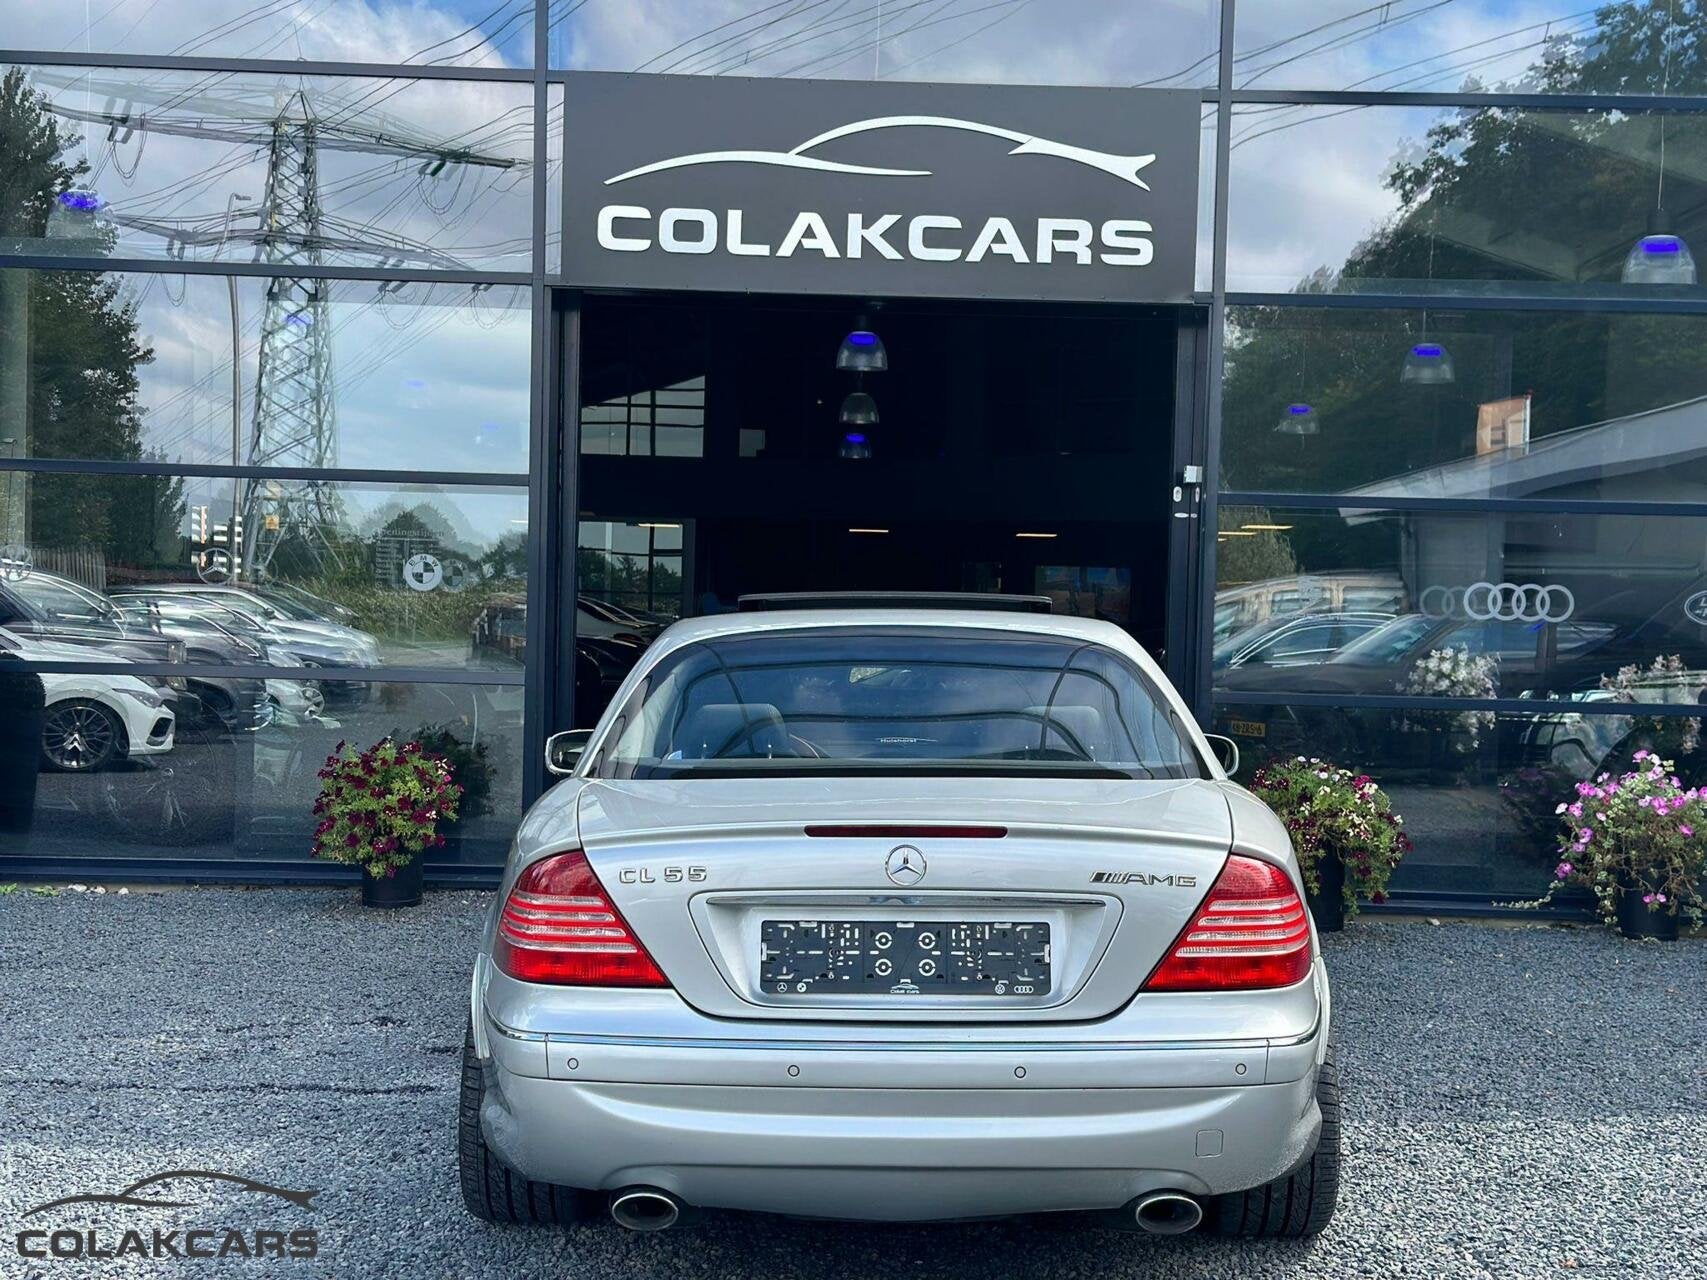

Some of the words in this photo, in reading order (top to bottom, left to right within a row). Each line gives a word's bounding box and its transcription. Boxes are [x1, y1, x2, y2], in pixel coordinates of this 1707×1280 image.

[597, 205, 1154, 266] COLAKCARS
[619, 868, 656, 884] CL
[664, 866, 707, 882] 55
